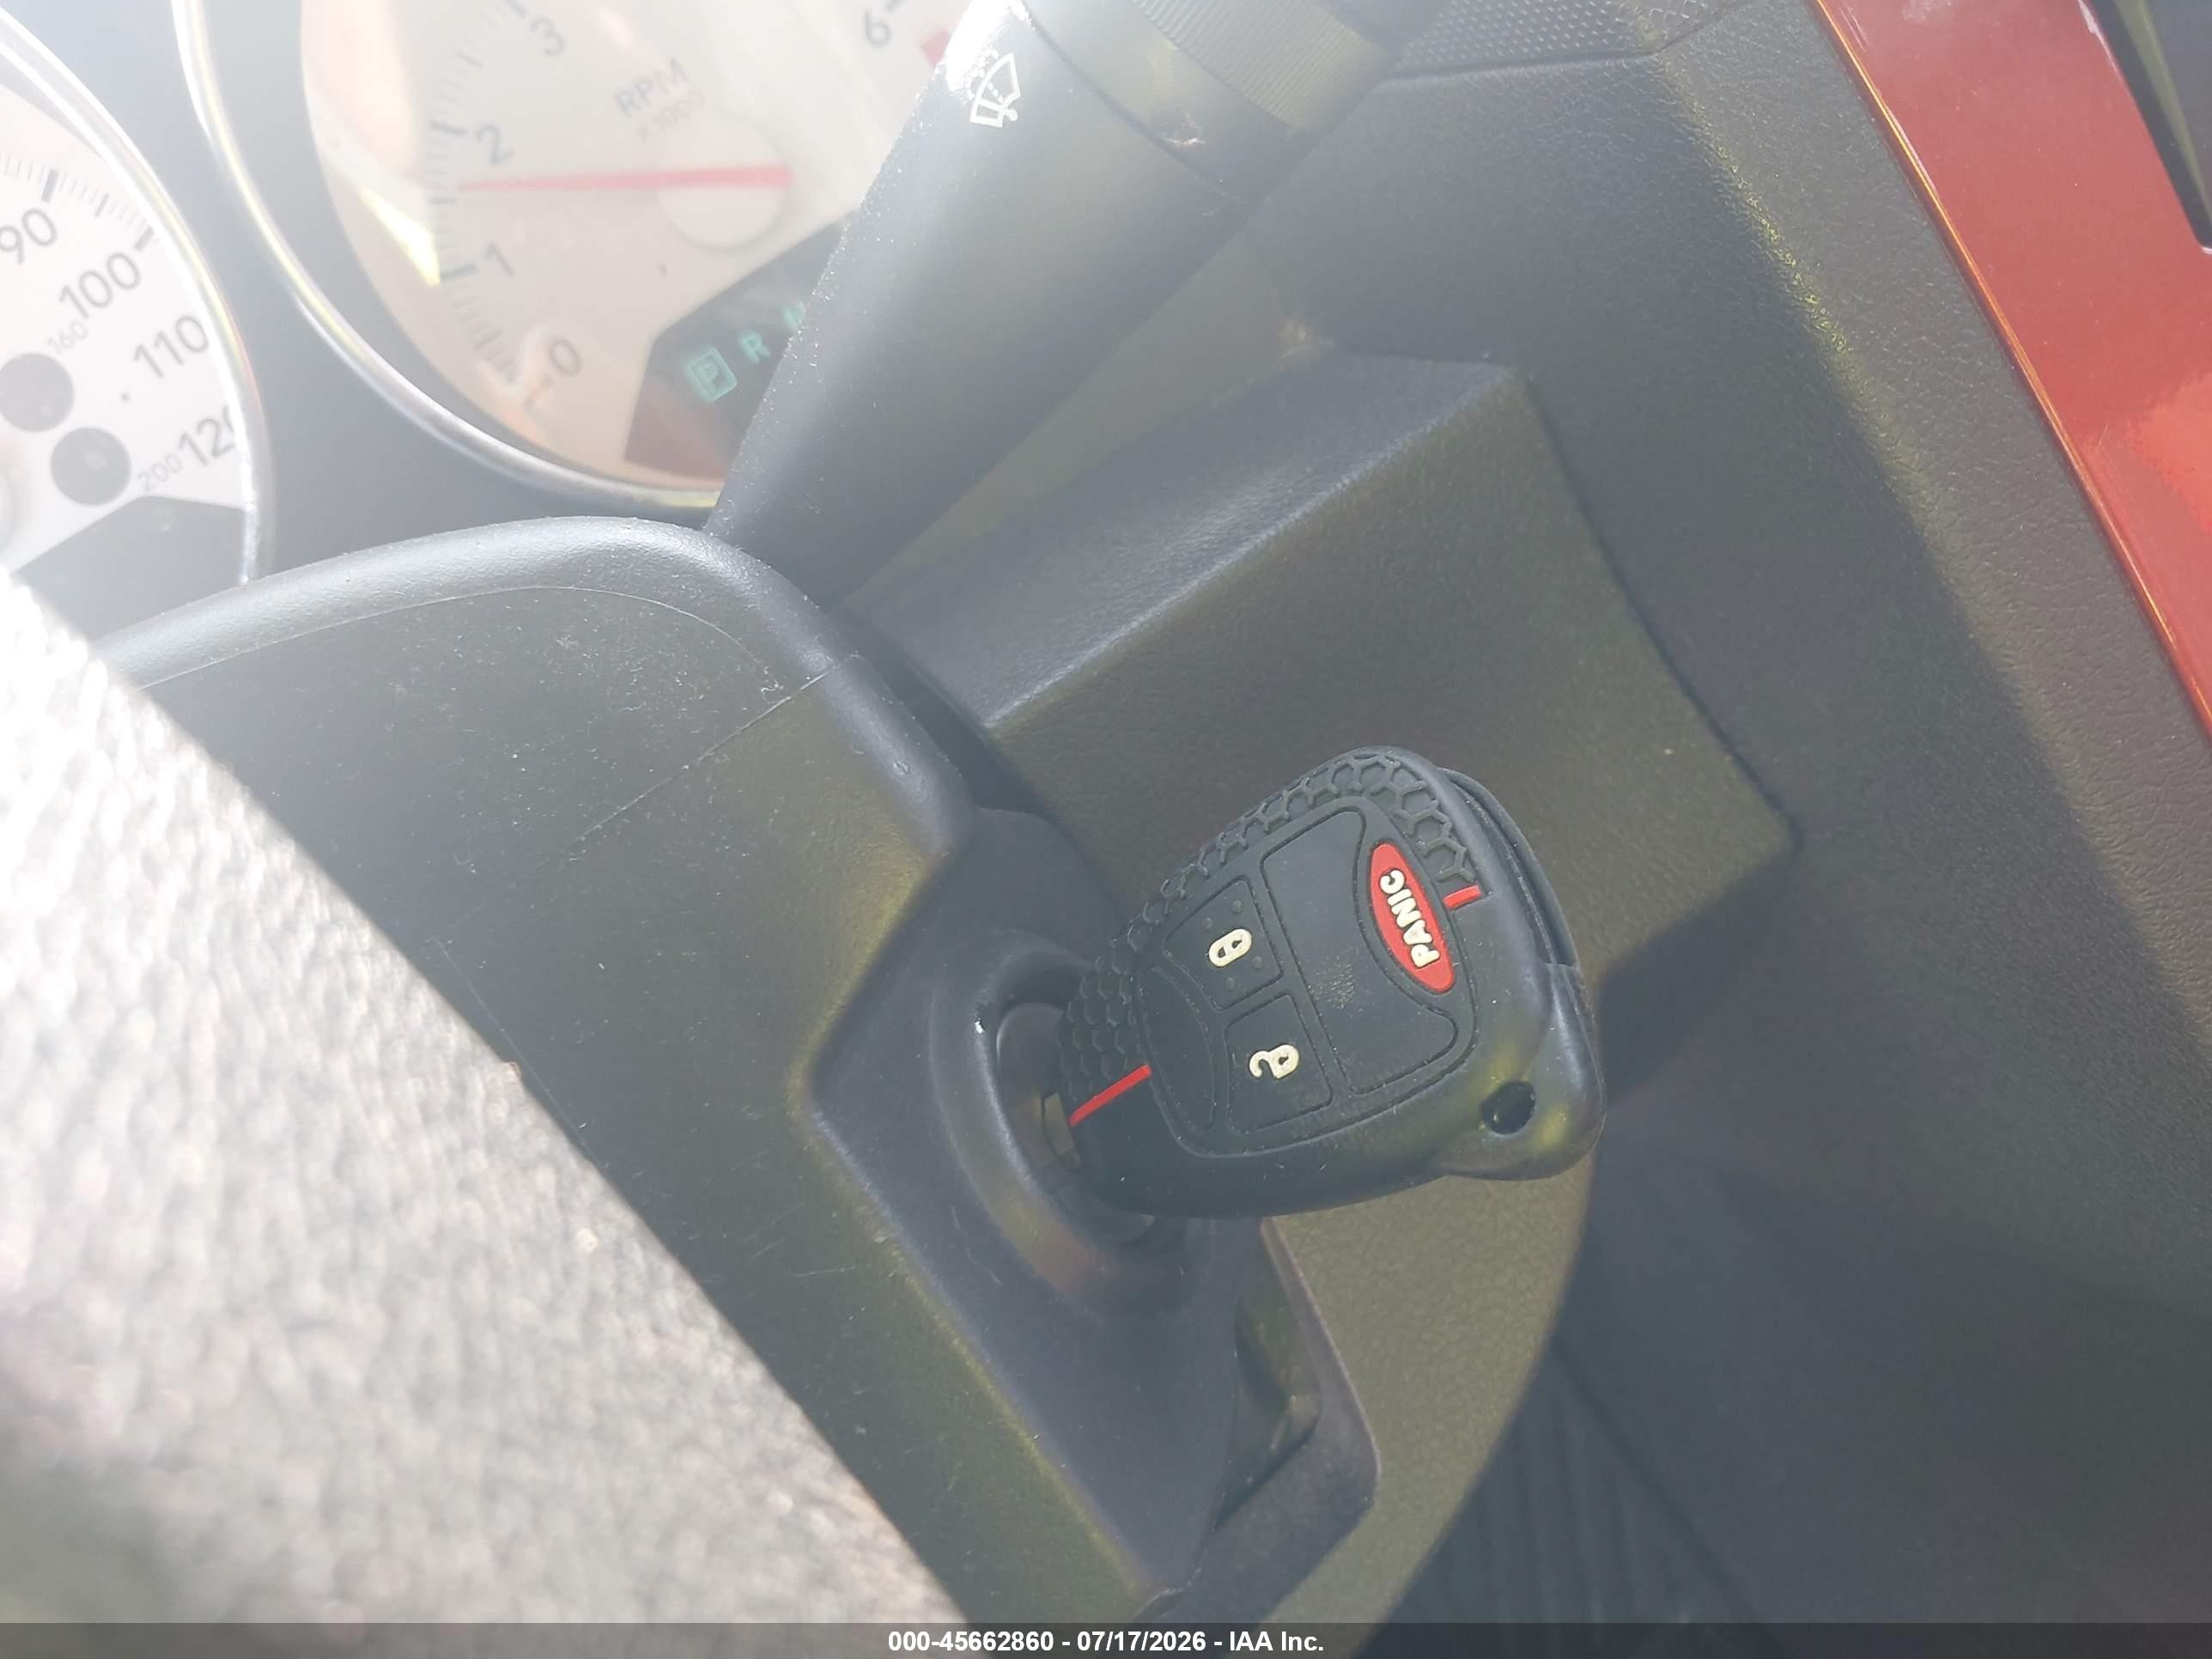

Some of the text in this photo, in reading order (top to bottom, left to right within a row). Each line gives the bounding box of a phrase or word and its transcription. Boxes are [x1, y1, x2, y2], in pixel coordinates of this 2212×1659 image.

[529, 16, 566, 57] 3
[864, 9, 891, 46] 6
[613, 57, 689, 118] RPM
[477, 125, 514, 165] 2
[0, 208, 57, 264] 90
[486, 242, 514, 278] 1
[58, 252, 141, 320] 100
[46, 320, 88, 355] 160
[133, 314, 210, 380] 110
[738, 330, 771, 364] R
[550, 339, 581, 377] 0
[137, 453, 184, 492] 200
[1380, 869, 1441, 968] PANIC
